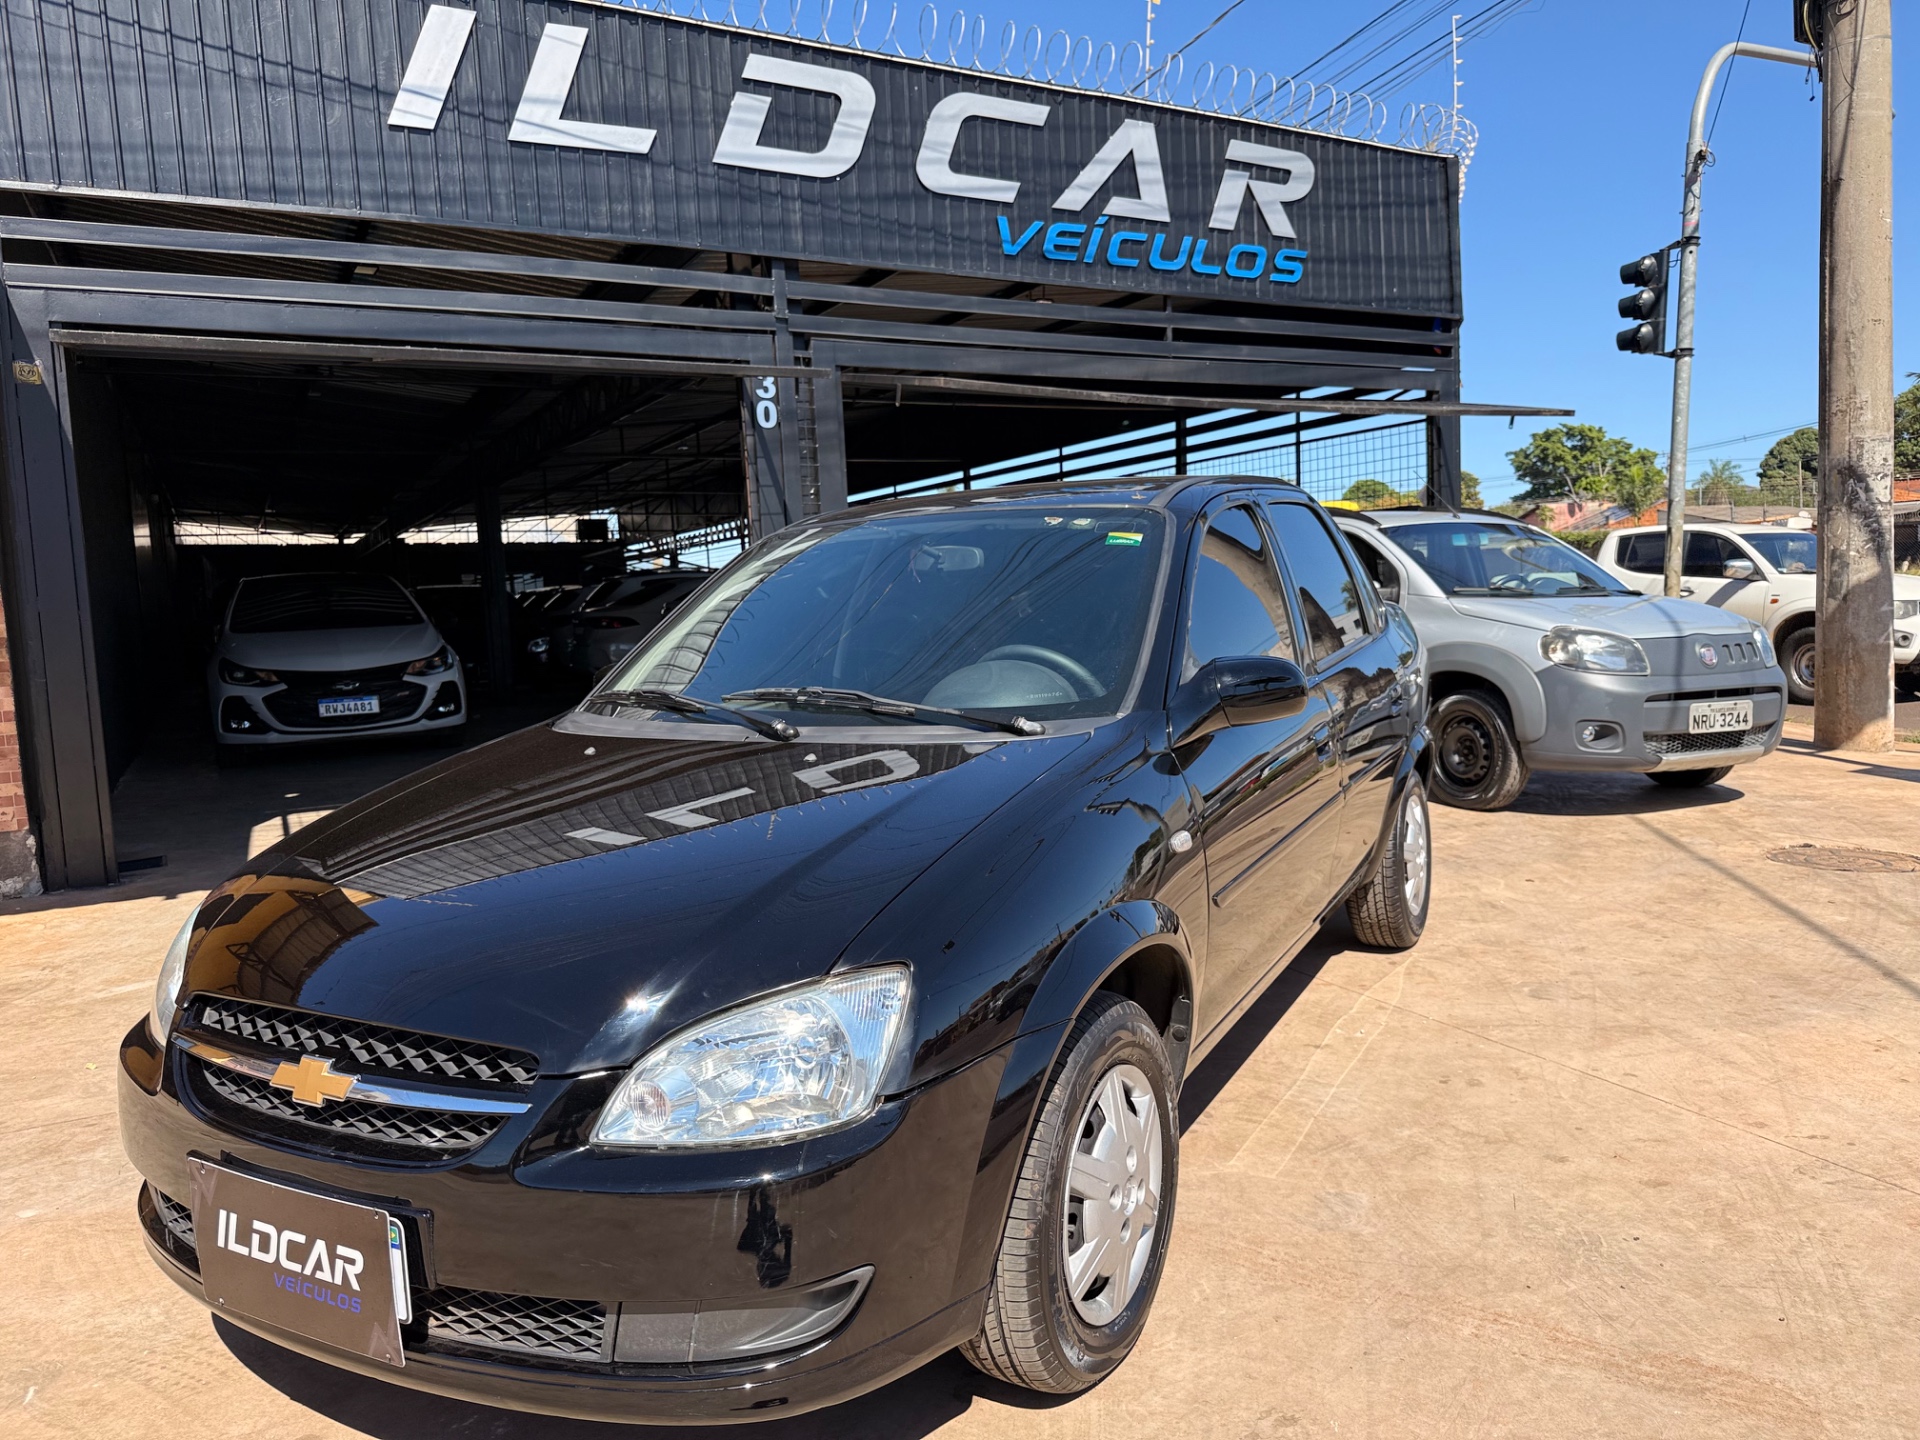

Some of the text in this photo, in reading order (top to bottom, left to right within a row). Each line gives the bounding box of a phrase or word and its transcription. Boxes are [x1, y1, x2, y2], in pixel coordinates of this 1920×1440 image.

[388, 4, 1316, 239] ILDCAR
[996, 215, 1308, 284] VEÍCULOS
[755, 376, 778, 429] 30
[324, 701, 374, 715] RWJ4A81
[217, 1208, 365, 1292] ILDCAR
[273, 1271, 362, 1314] VEÍCULOS
